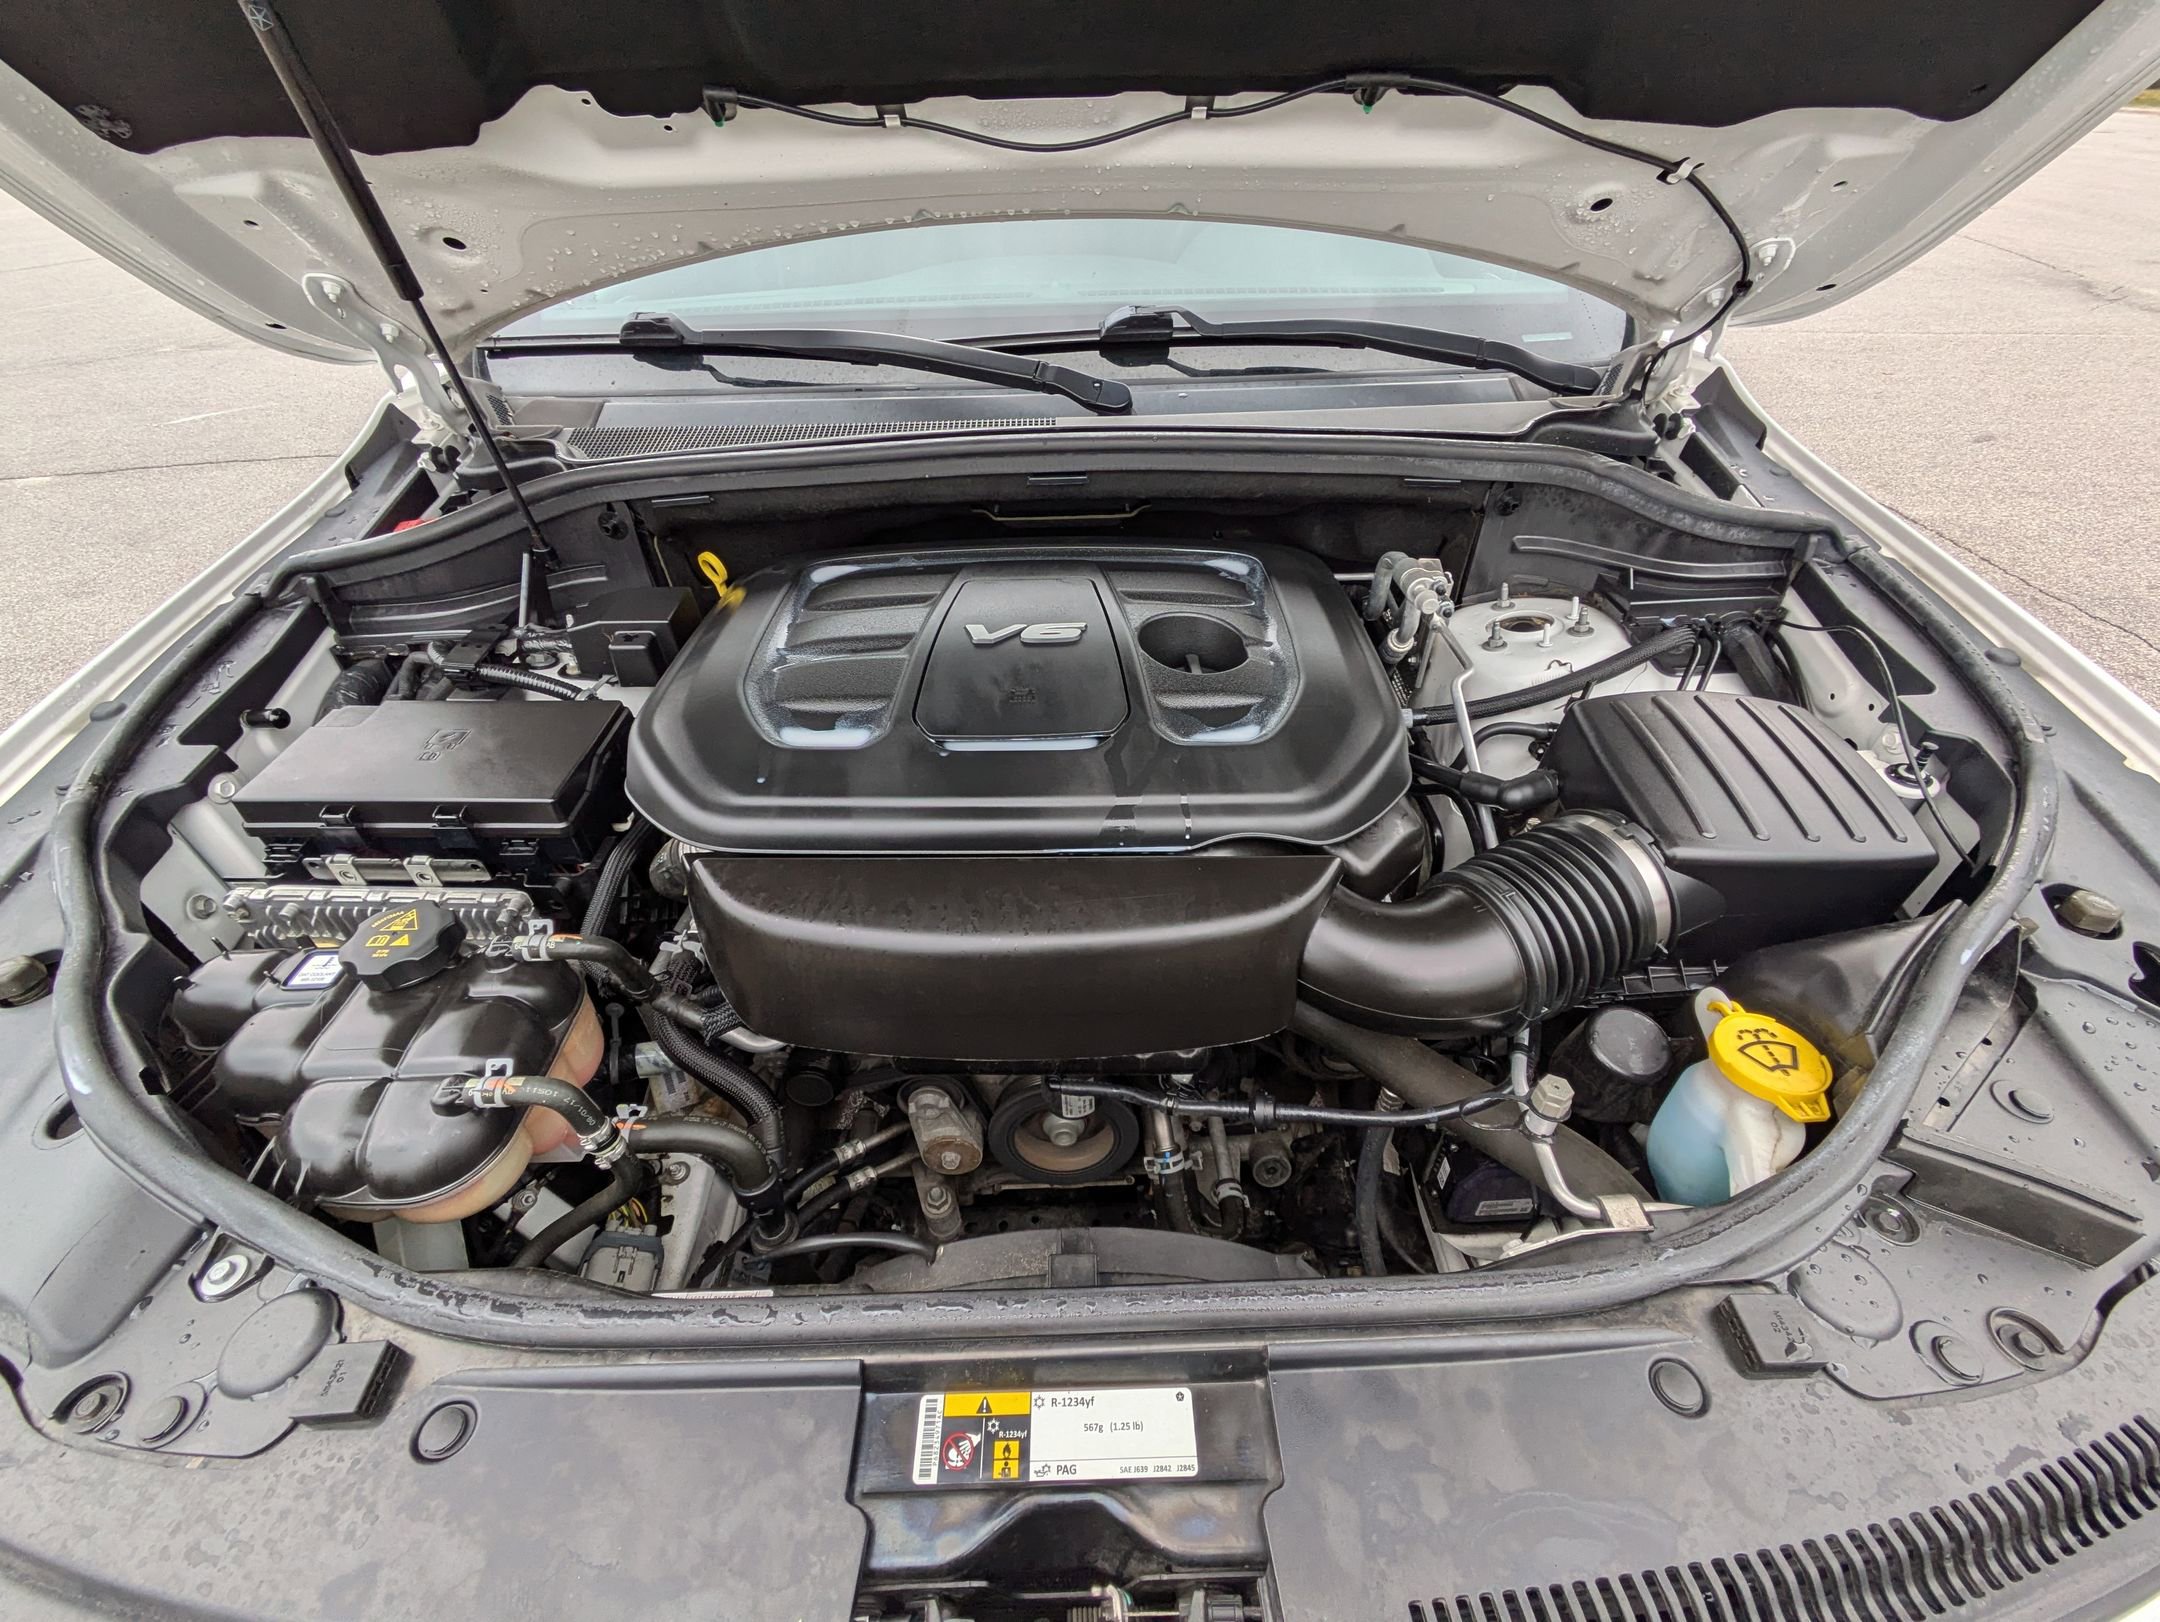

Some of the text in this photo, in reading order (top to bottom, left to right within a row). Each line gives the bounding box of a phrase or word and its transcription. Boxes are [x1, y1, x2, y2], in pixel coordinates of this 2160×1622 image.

[964, 622, 1088, 644] V6
[1051, 1396, 1095, 1408] R-1234yf
[1083, 1420, 1144, 1433] 567g (1.25 lb)
[998, 1429, 1028, 1439] R-1234yf
[1056, 1464, 1077, 1475] PAG
[1119, 1465, 1133, 1474] SAE
[1133, 1465, 1149, 1474] J639
[1153, 1464, 1172, 1473] J2842
